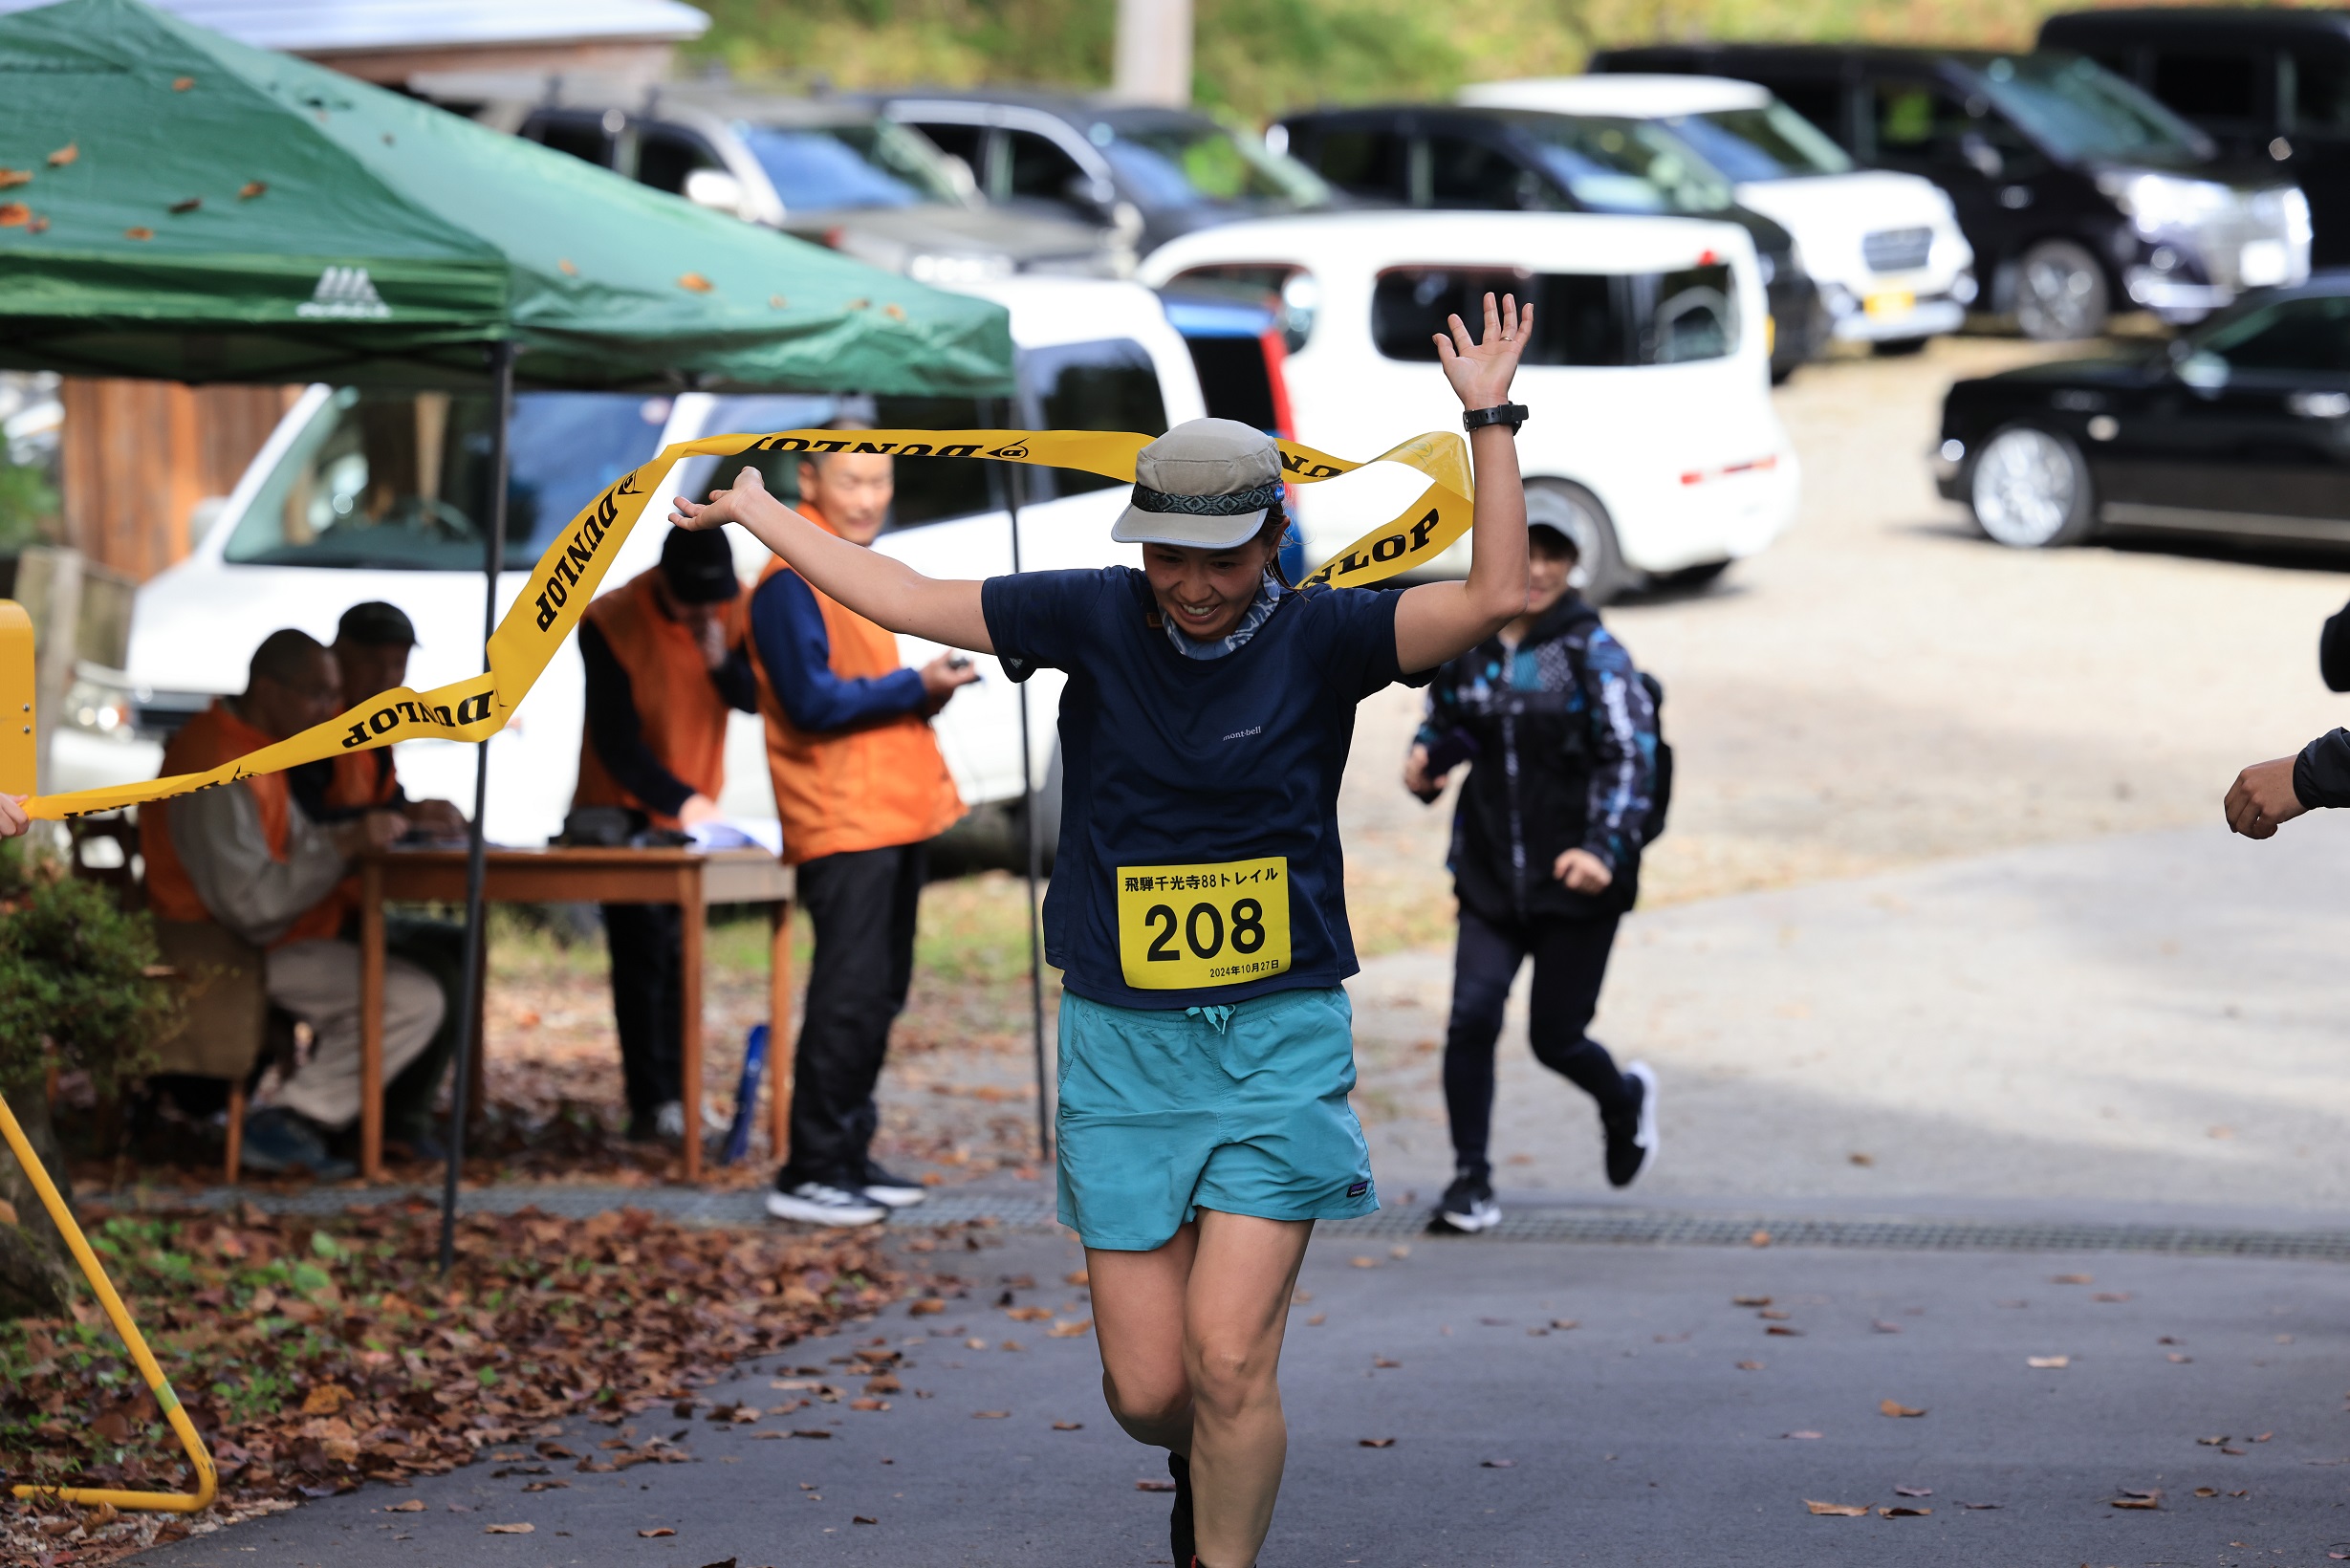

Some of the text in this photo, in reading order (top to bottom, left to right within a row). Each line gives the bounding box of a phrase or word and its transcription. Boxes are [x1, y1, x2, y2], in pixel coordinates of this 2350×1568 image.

[535, 486, 619, 633] DUNLOP
[341, 689, 494, 749] DUNLOP
[1124, 867, 1279, 892] 飛騨千光寺88トレイル
[1144, 897, 1266, 963] 208
[1209, 959, 1279, 978] 2024年10月27日
